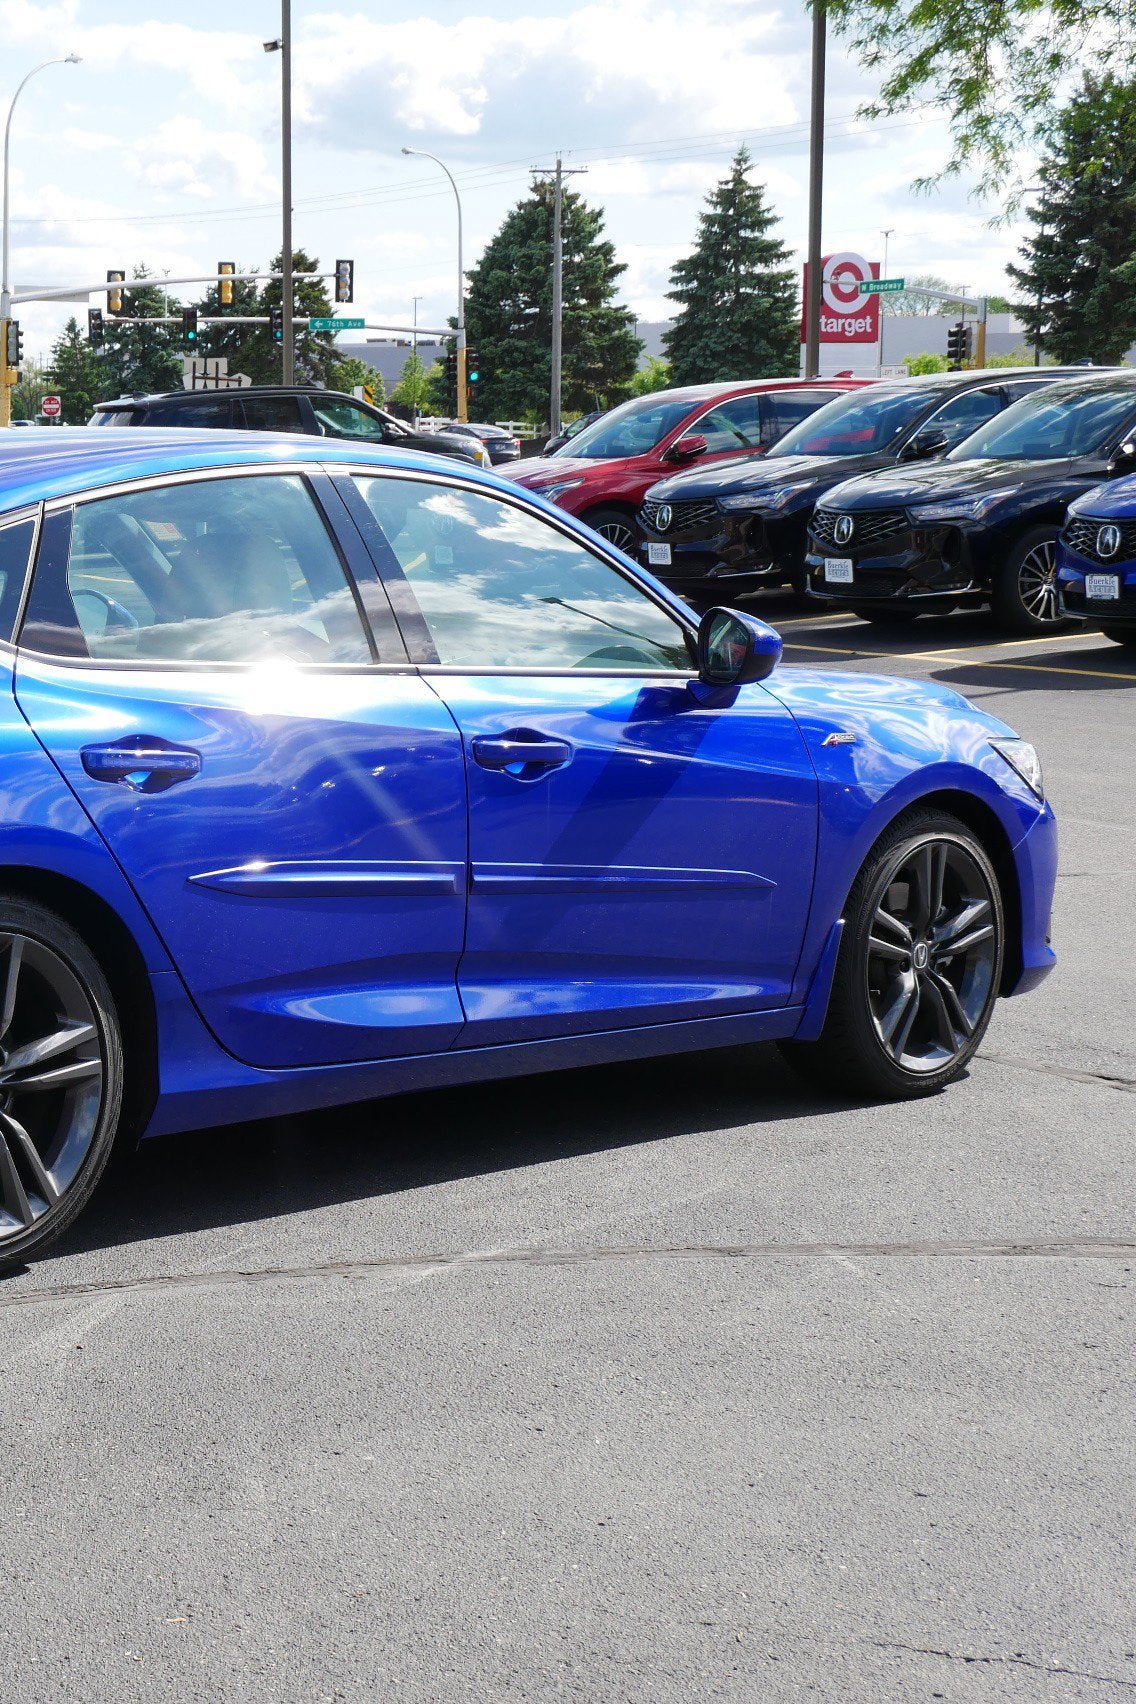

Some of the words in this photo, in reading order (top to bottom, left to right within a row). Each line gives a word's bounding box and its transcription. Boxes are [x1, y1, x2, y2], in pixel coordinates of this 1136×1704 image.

[861, 284, 867, 292] N
[869, 282, 902, 291] Broadway
[327, 320, 344, 328] 76th
[819, 315, 873, 337] target
